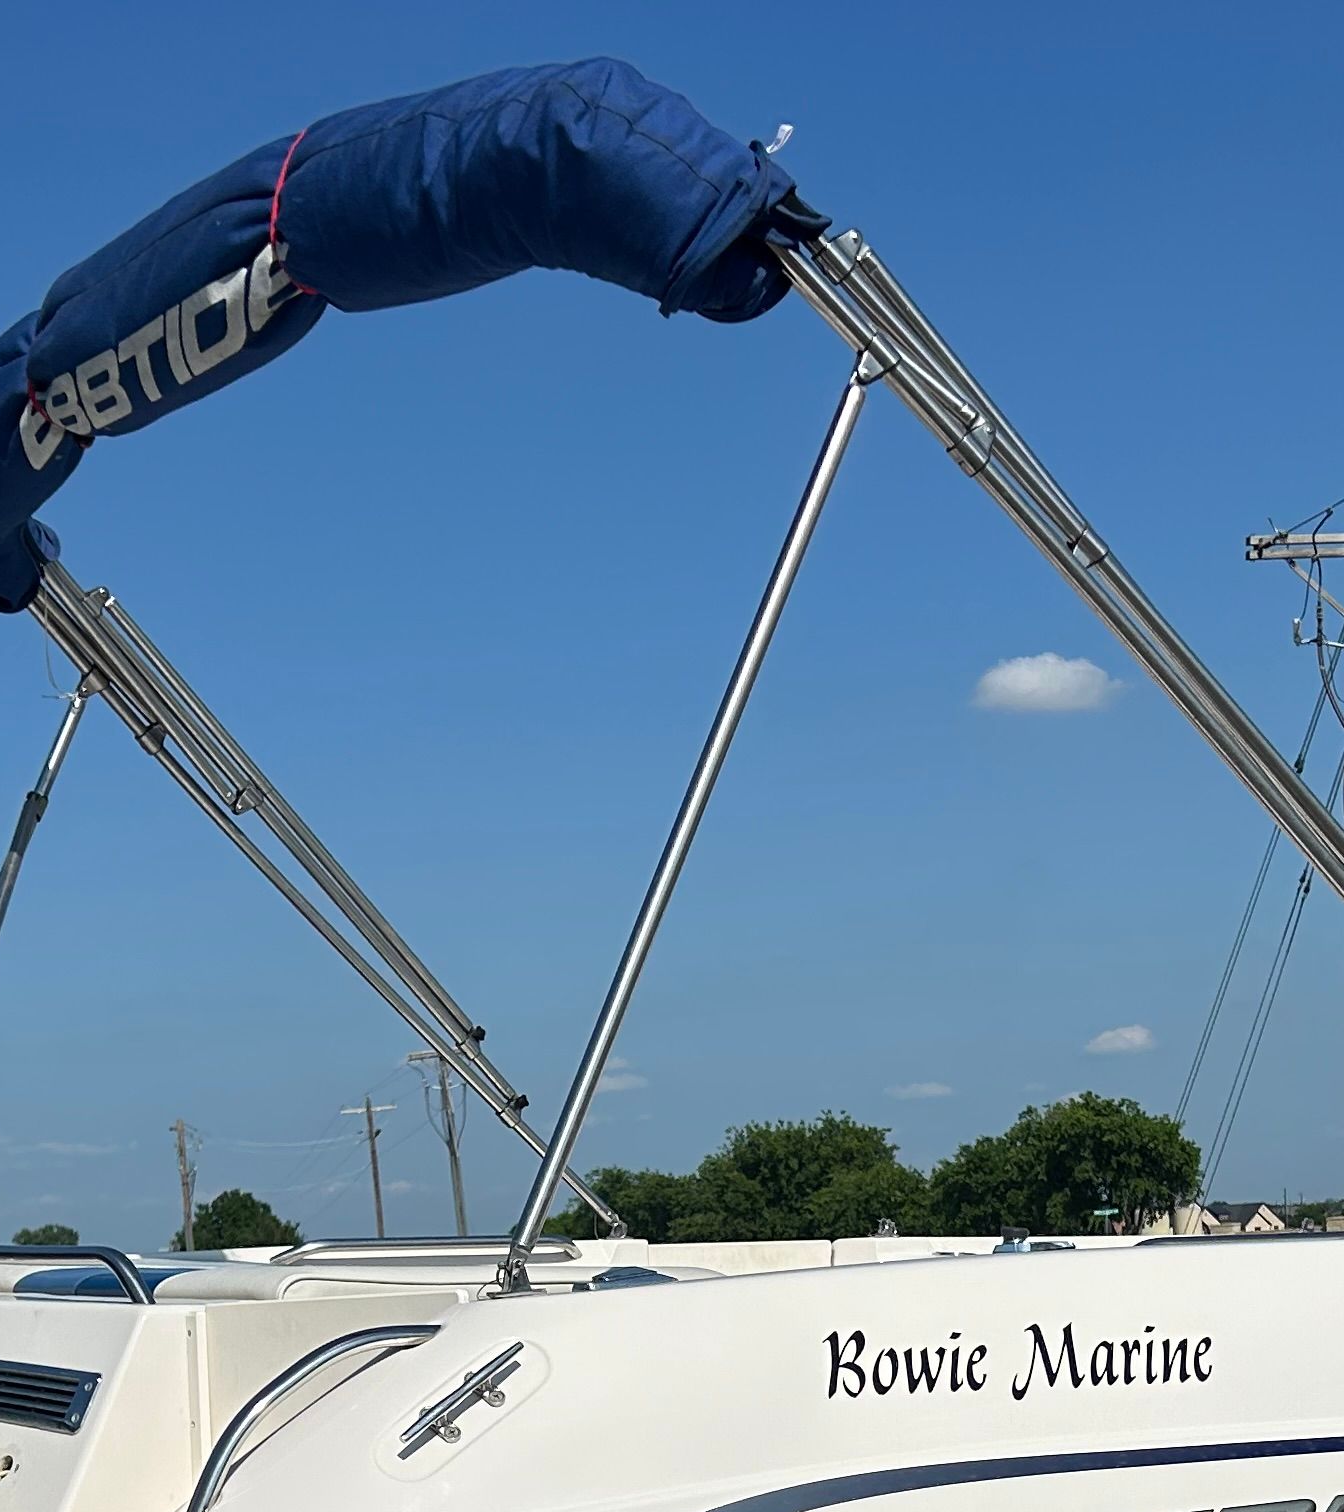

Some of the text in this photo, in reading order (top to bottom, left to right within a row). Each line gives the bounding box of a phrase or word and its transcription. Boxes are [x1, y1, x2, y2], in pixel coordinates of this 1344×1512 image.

[19, 241, 305, 471] EBBTIDE
[822, 1321, 1213, 1401] Bowie Marine
